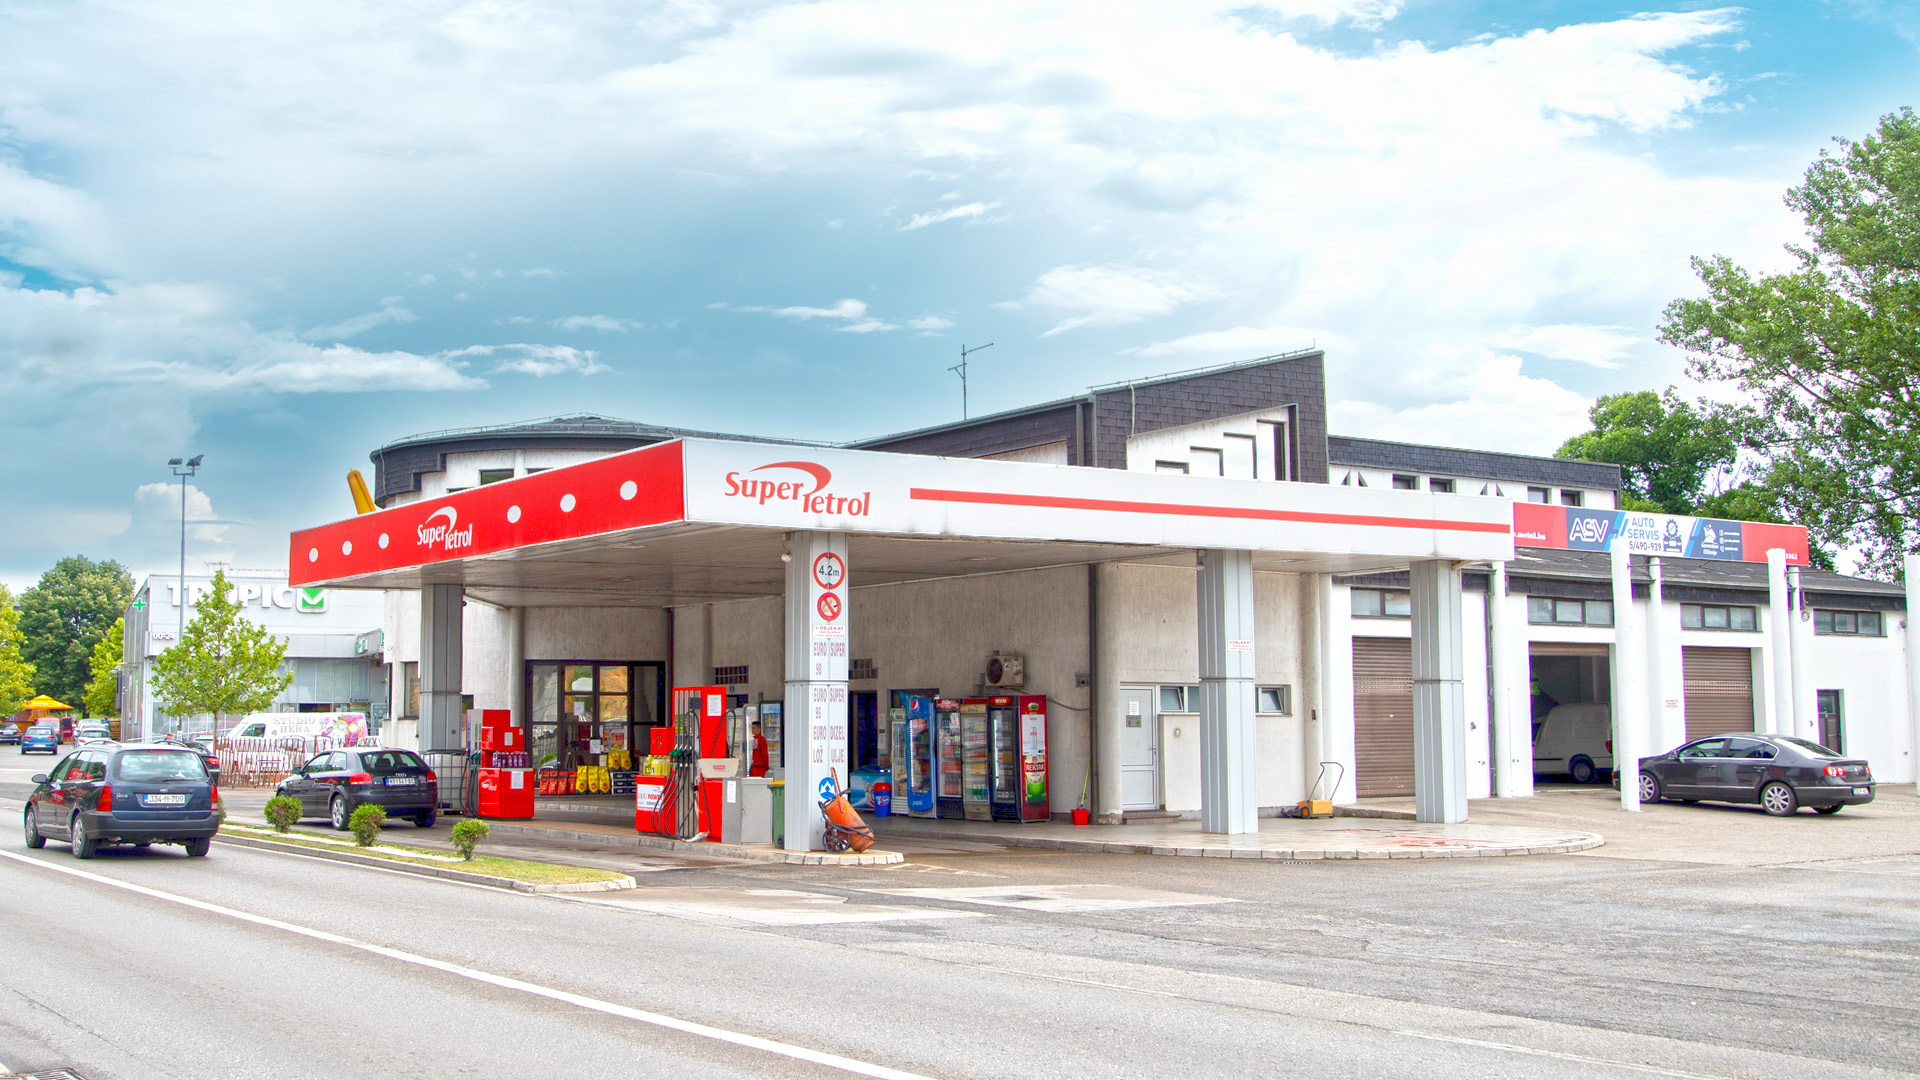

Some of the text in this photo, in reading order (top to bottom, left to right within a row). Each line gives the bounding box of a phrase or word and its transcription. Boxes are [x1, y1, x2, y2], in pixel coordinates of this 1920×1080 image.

[725, 471, 804, 505] Super
[1631, 517, 1655, 528] AUTO
[417, 524, 446, 549] Super
[1569, 517, 1609, 543] ASV
[1627, 528, 1660, 541] SERVIS
[818, 564, 840, 576] 4.2m
[152, 632, 175, 641] 00-24
[813, 642, 845, 657] EURO SUPER
[815, 663, 822, 676] 98
[813, 688, 845, 702] EURO SUPER
[815, 706, 822, 719] 95
[273, 717, 316, 725] STUDIO
[280, 725, 311, 734] HERA
[813, 725, 845, 740] EURO DIZEL
[830, 748, 845, 763] ULJE
[1026, 762, 1044, 771] NEKTAR
[149, 795, 184, 803] J34-M-709
